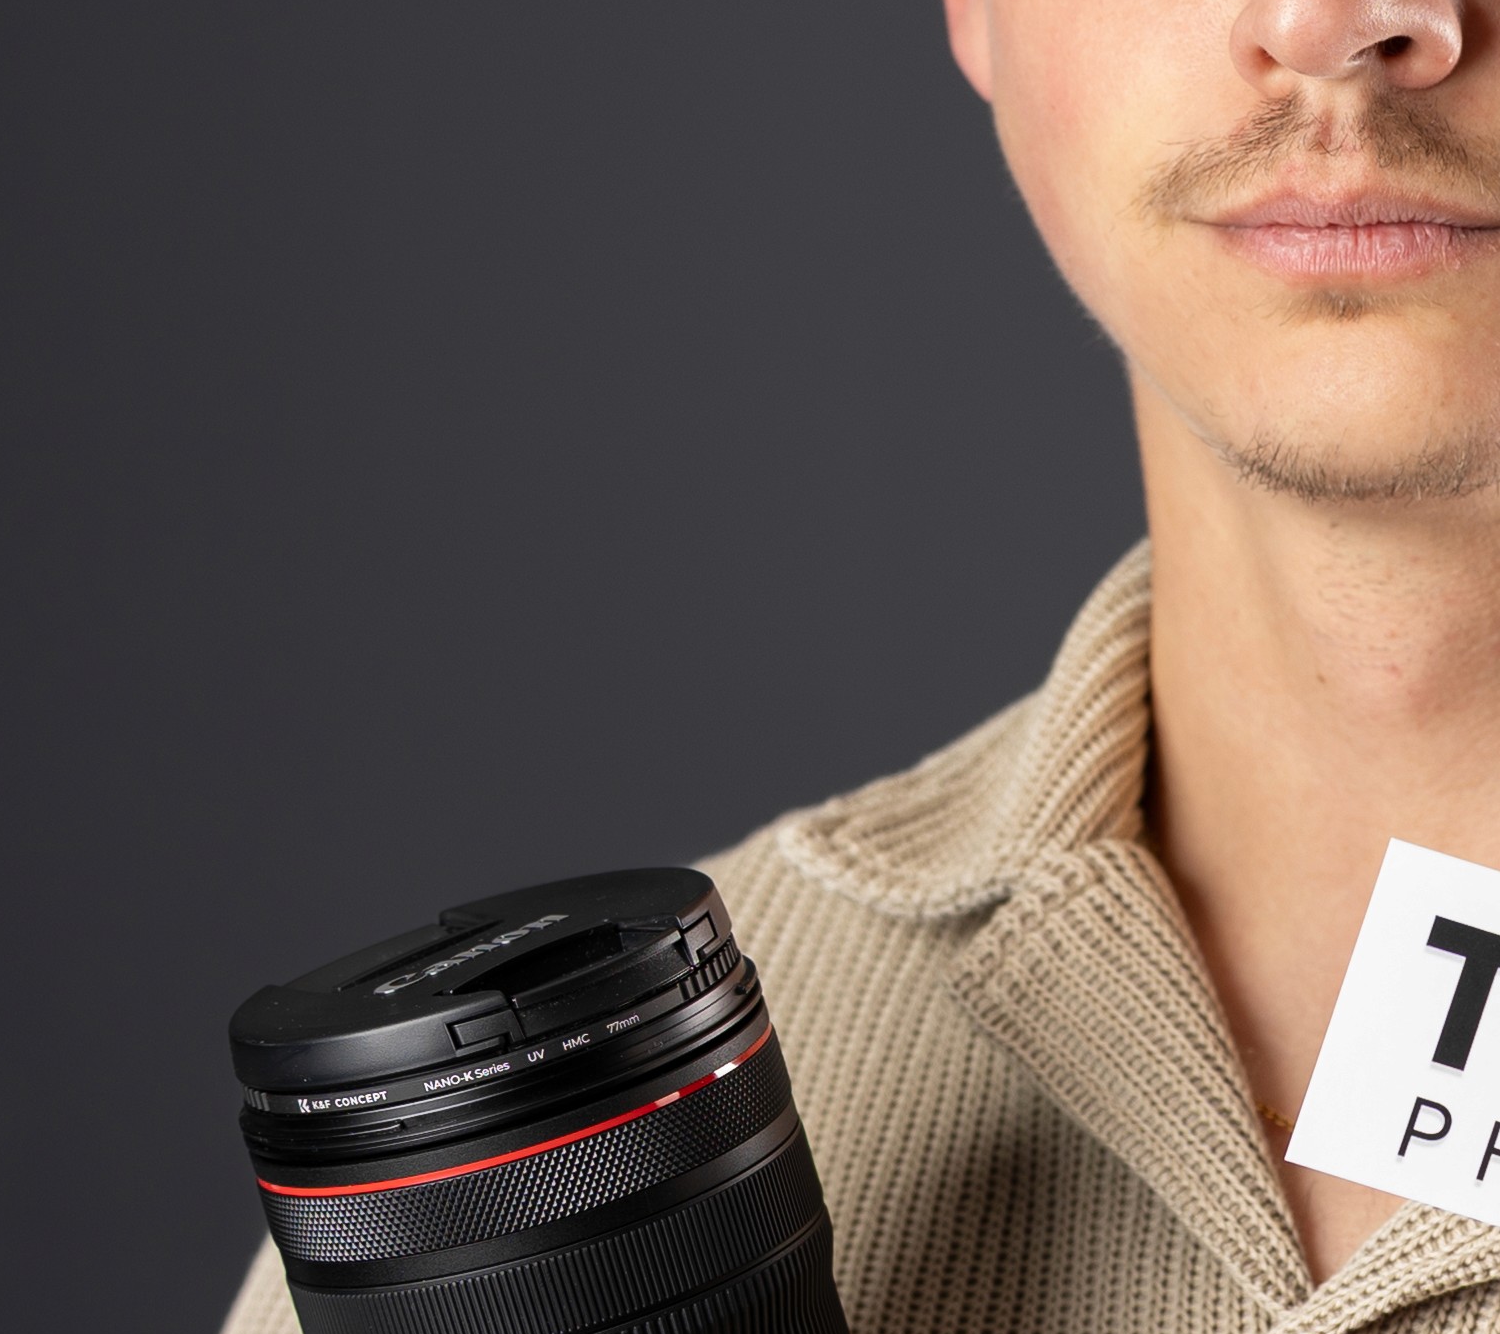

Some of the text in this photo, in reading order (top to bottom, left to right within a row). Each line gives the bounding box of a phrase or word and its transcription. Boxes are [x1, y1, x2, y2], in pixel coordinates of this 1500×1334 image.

[373, 914, 570, 995] Canon
[312, 1014, 640, 1110] K&F CONCEPT NANO-K Series UV HMC 77mm
